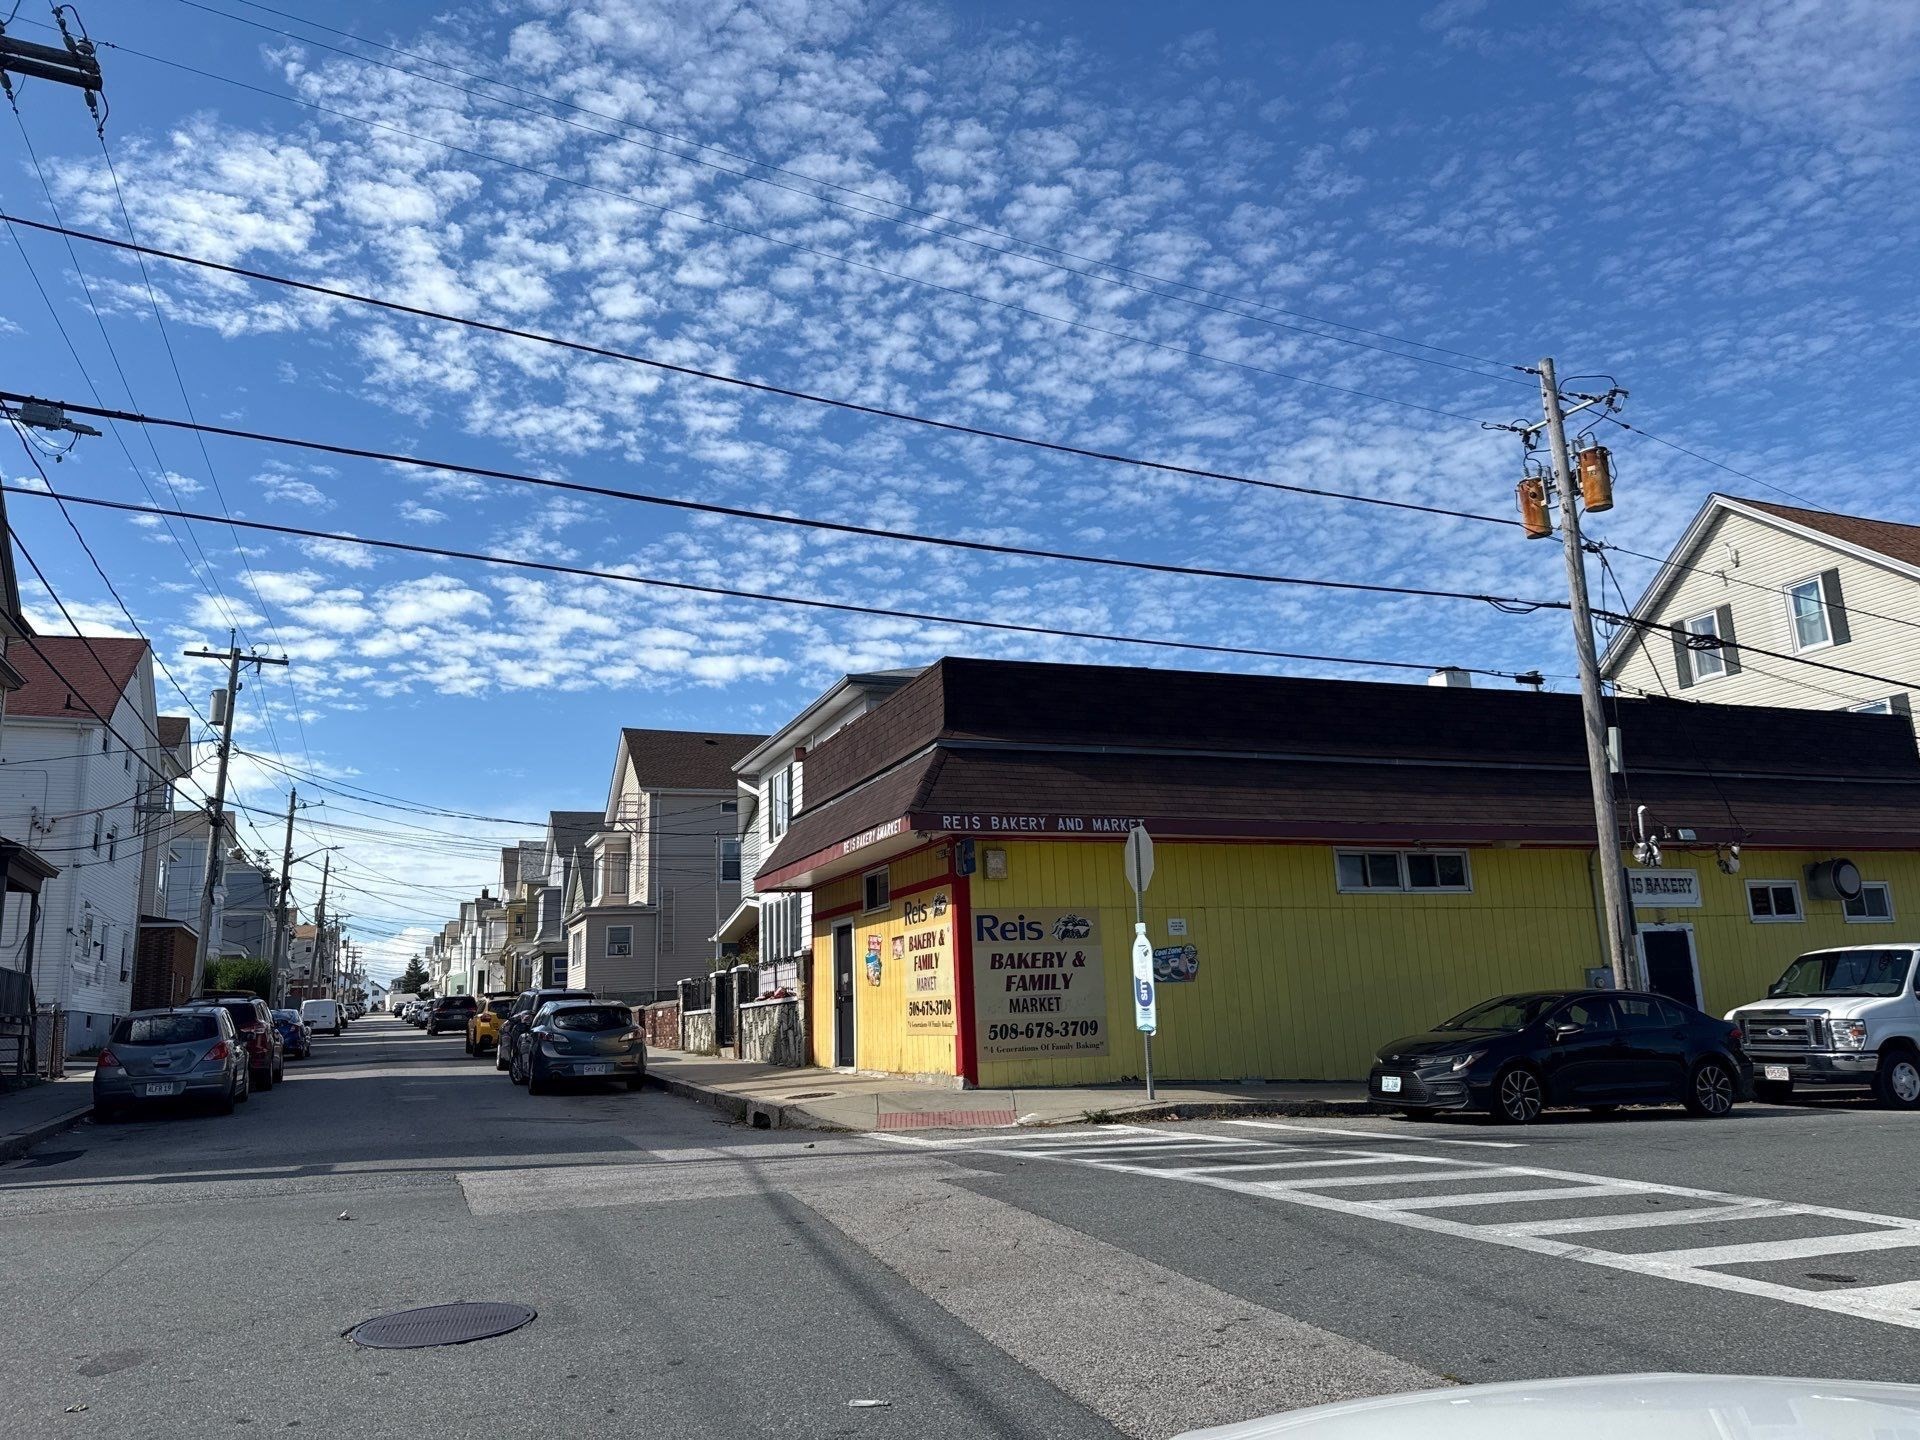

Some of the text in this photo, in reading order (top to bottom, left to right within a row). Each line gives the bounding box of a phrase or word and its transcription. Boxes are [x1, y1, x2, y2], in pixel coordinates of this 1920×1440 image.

[942, 815, 1145, 832] REIS BAKERY AND MARKET
[843, 838, 856, 854] REIS
[856, 829, 876, 849] BAKERY
[1631, 877, 1693, 894] IS BAKERY
[904, 898, 928, 926] Reis
[976, 914, 1044, 942] Reis
[908, 929, 945, 952] BAKERY &
[914, 952, 940, 972] FAMILY
[990, 950, 1086, 970] BAKERY &
[916, 975, 937, 992] MARKET
[1005, 973, 1073, 992] FAMILY
[908, 999, 952, 1017] 508-678-3709
[1009, 997, 1062, 1013] MARKET
[988, 1020, 1098, 1040] 508-678-3709
[996, 1044, 1039, 1053] Generations
[1040, 1043, 1050, 1051] Of
[1051, 1042, 1073, 1052] Family
